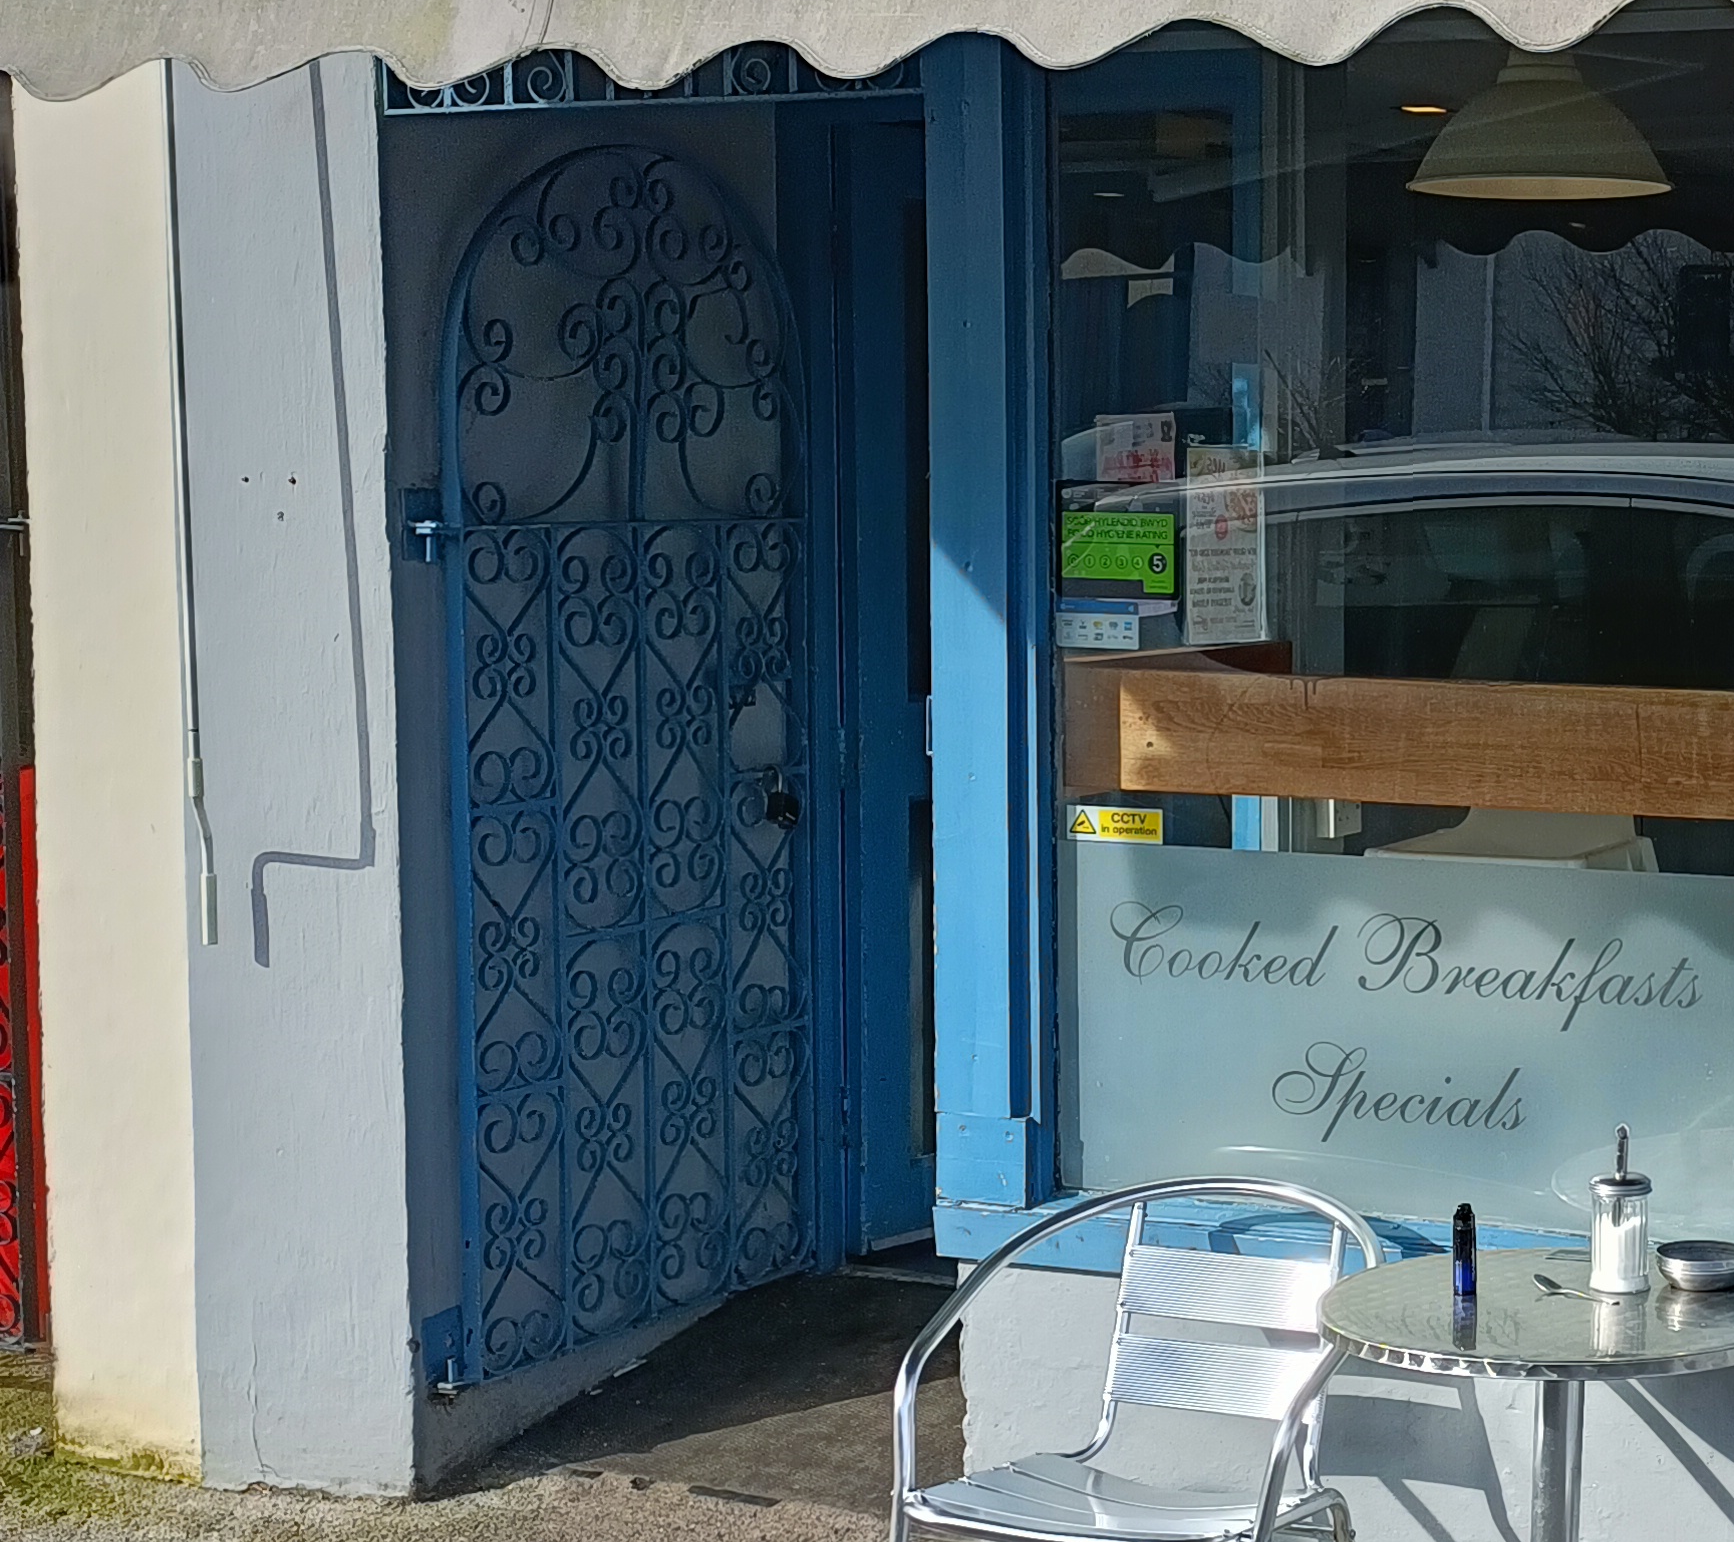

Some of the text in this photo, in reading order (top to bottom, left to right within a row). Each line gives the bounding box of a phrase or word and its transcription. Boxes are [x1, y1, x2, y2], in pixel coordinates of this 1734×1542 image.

[1140, 518, 1168, 528] BWYD
[1096, 529, 1134, 539] HYGIENE
[1135, 530, 1168, 540] RATING
[1152, 555, 1163, 572] 5
[1110, 812, 1147, 825] CCTV
[1100, 823, 1158, 836] in operation
[1109, 900, 1704, 1032] Cooked Breakfasts
[1272, 1041, 1528, 1143] Specials
